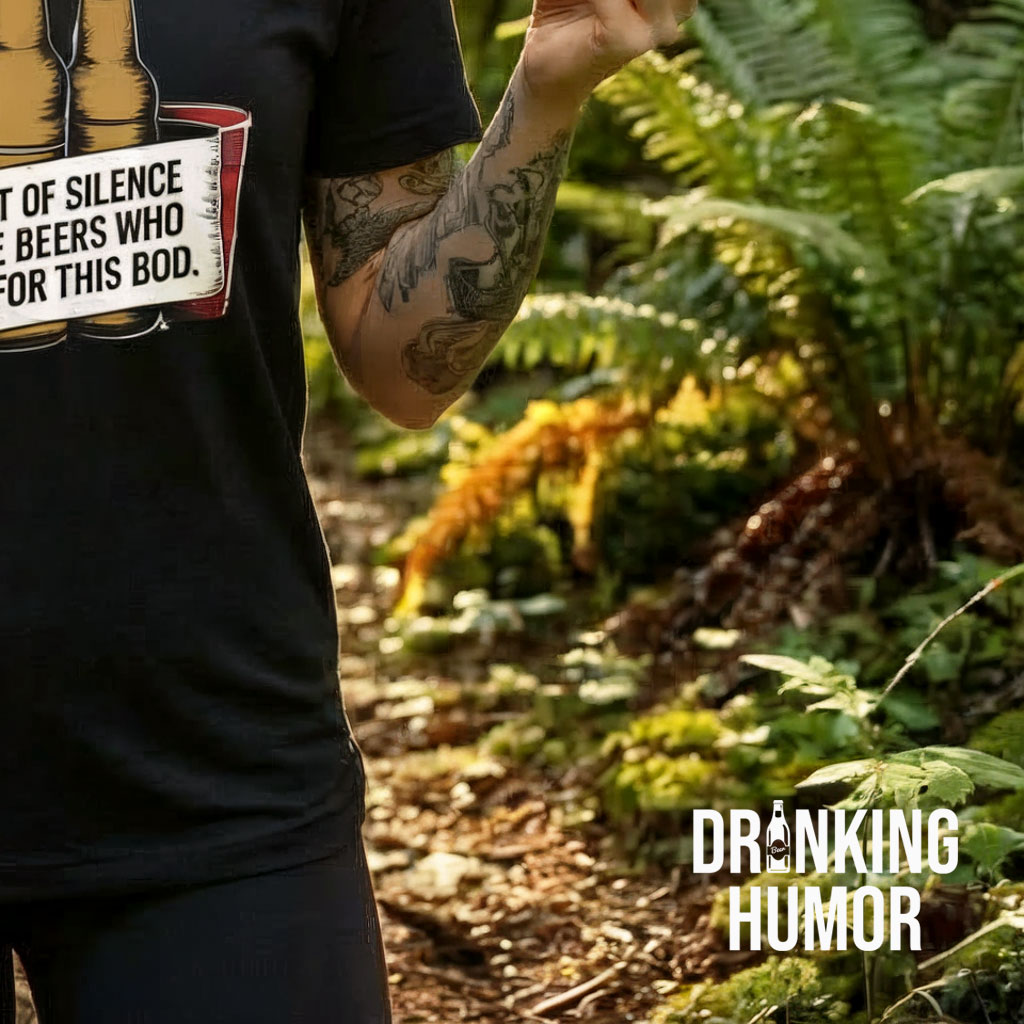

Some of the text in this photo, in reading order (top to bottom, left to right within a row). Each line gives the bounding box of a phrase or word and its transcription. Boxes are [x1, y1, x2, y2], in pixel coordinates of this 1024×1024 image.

[22, 179, 56, 217] OF
[65, 159, 183, 209] SILENCE
[15, 214, 107, 261] BEERS
[116, 202, 184, 245] WHO
[55, 256, 122, 298] THIS
[132, 246, 199, 287] BOD.
